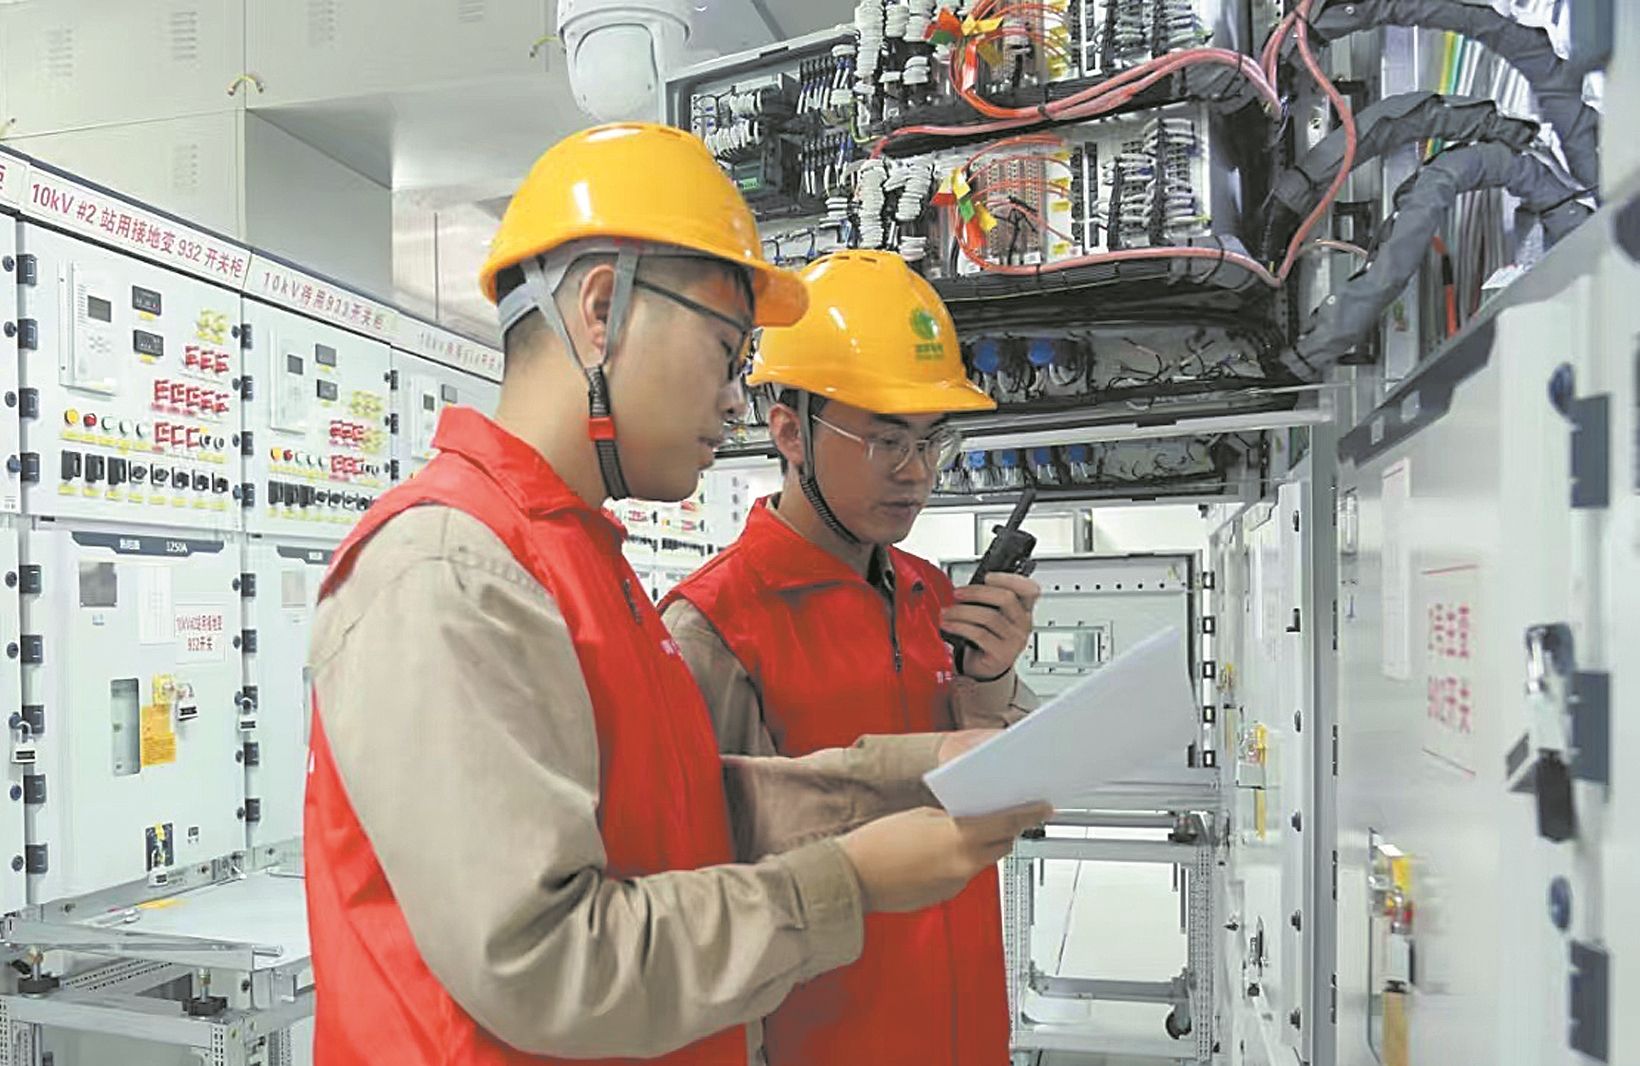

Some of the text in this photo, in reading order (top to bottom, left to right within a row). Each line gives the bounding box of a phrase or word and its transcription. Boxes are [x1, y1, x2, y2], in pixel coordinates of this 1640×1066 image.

[32, 183, 244, 279] 10kV #2 站用接地变 932 开关柜
